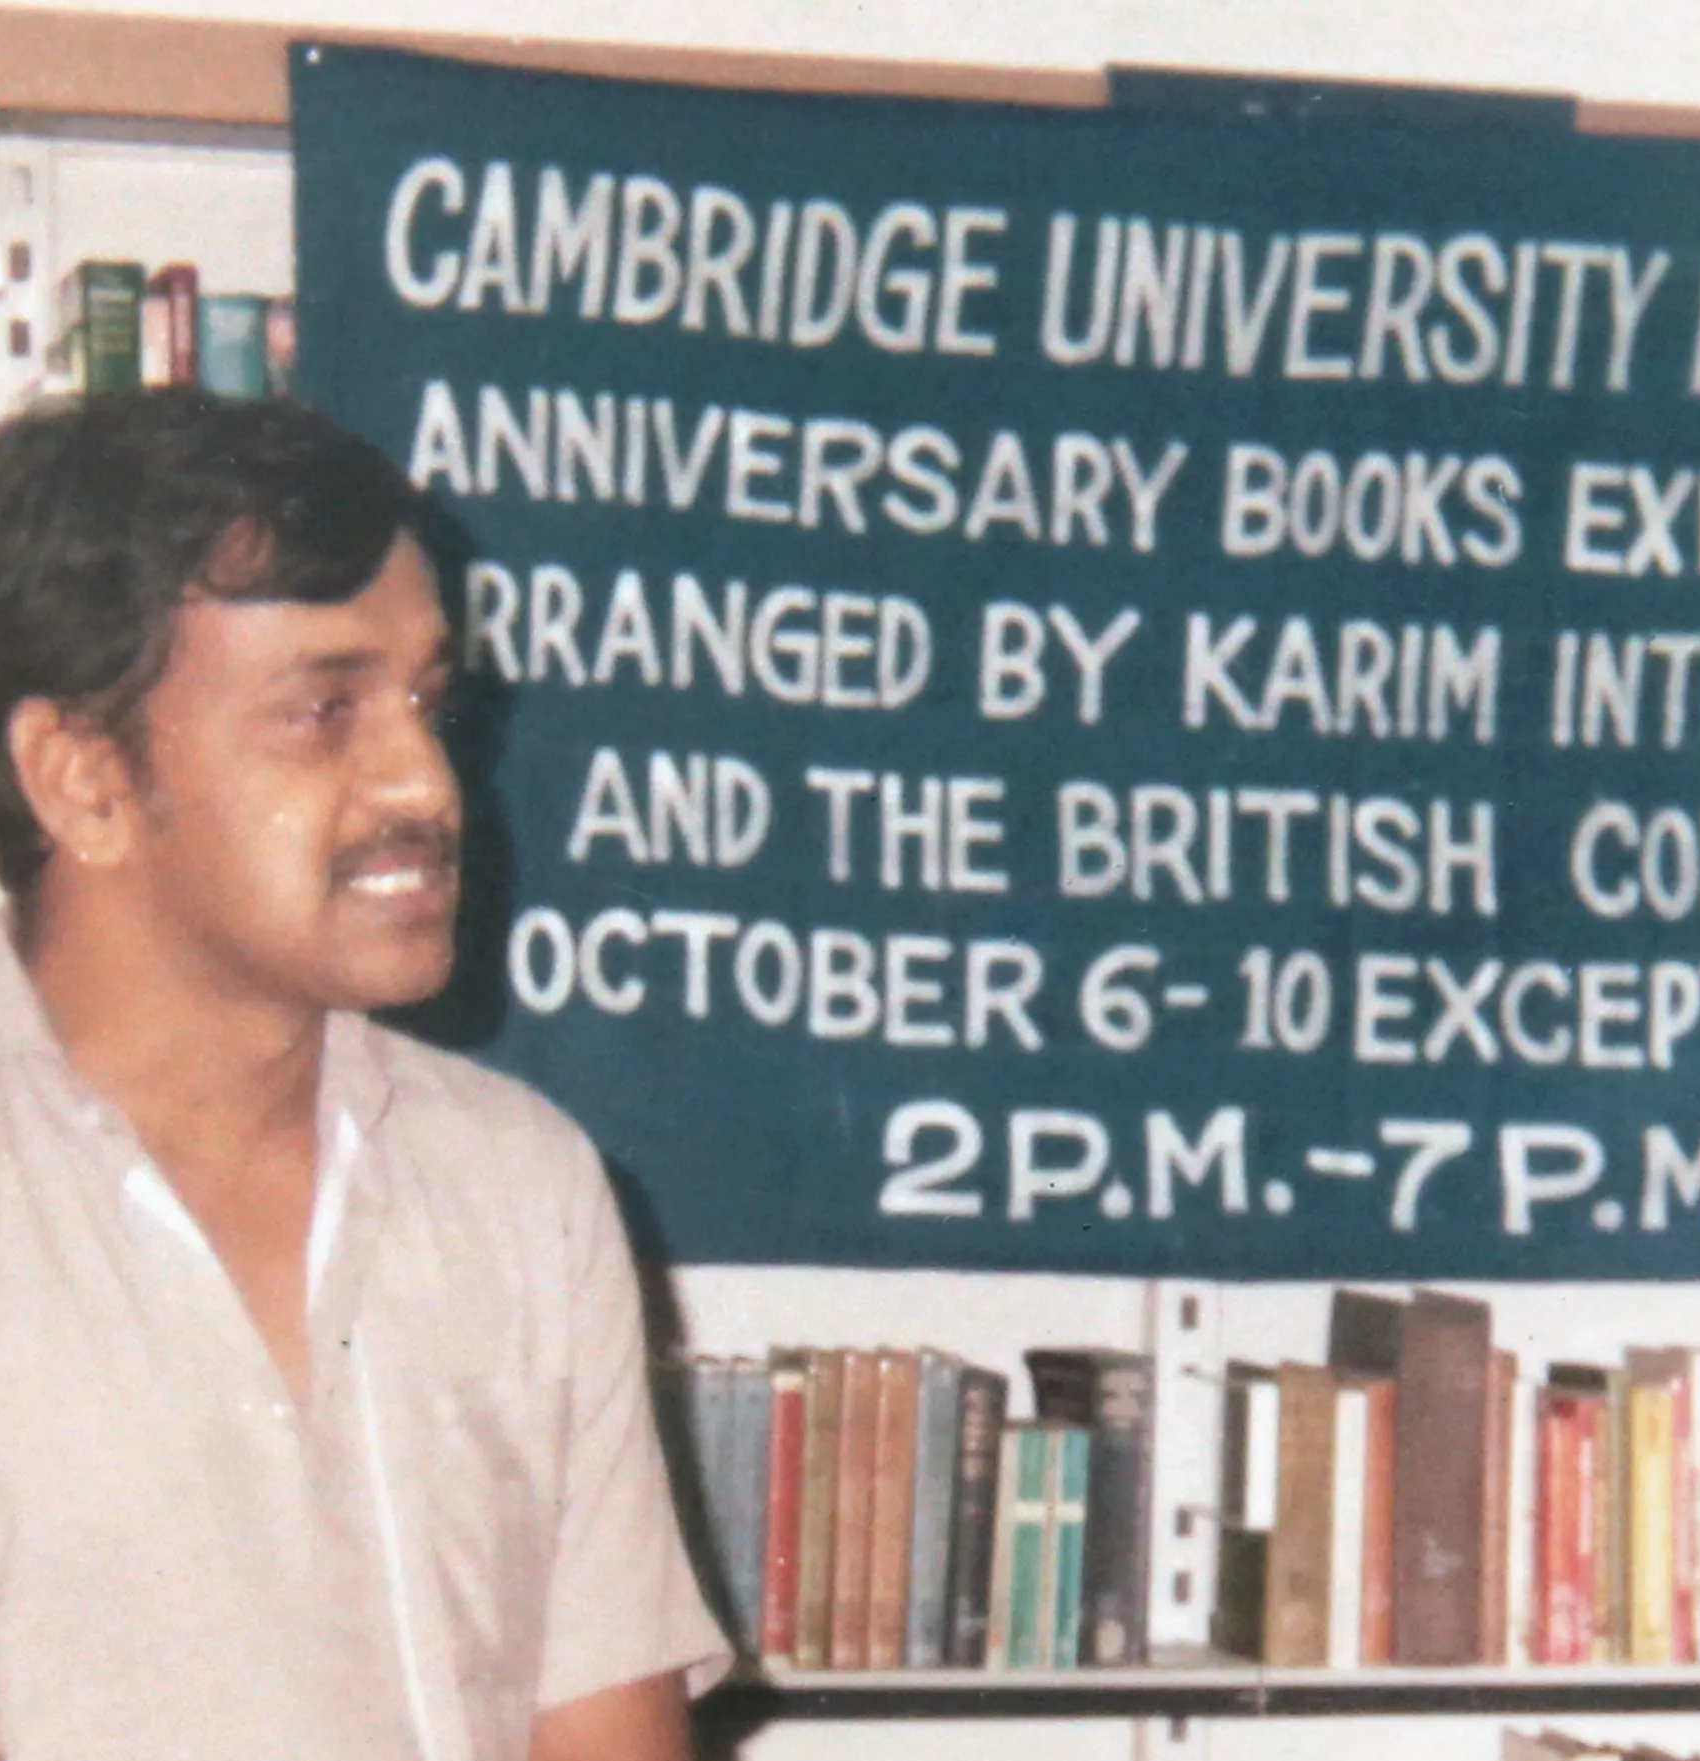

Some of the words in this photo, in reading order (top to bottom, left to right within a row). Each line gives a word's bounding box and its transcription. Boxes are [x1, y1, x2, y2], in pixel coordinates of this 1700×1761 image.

[385, 158, 1002, 355] CAMBRIDGE
[1042, 215, 1668, 389] UNIVERSITY
[407, 378, 1186, 552] ANNIVERSARY
[1222, 445, 1520, 566] BOOKS
[464, 560, 933, 710] RRANGED
[980, 603, 1139, 724] BY
[1184, 614, 1500, 742] KARIM
[568, 748, 770, 867] AND
[806, 767, 1008, 892] THE
[1058, 782, 1496, 915] BRITISH
[508, 908, 1043, 1051] OCTOBER
